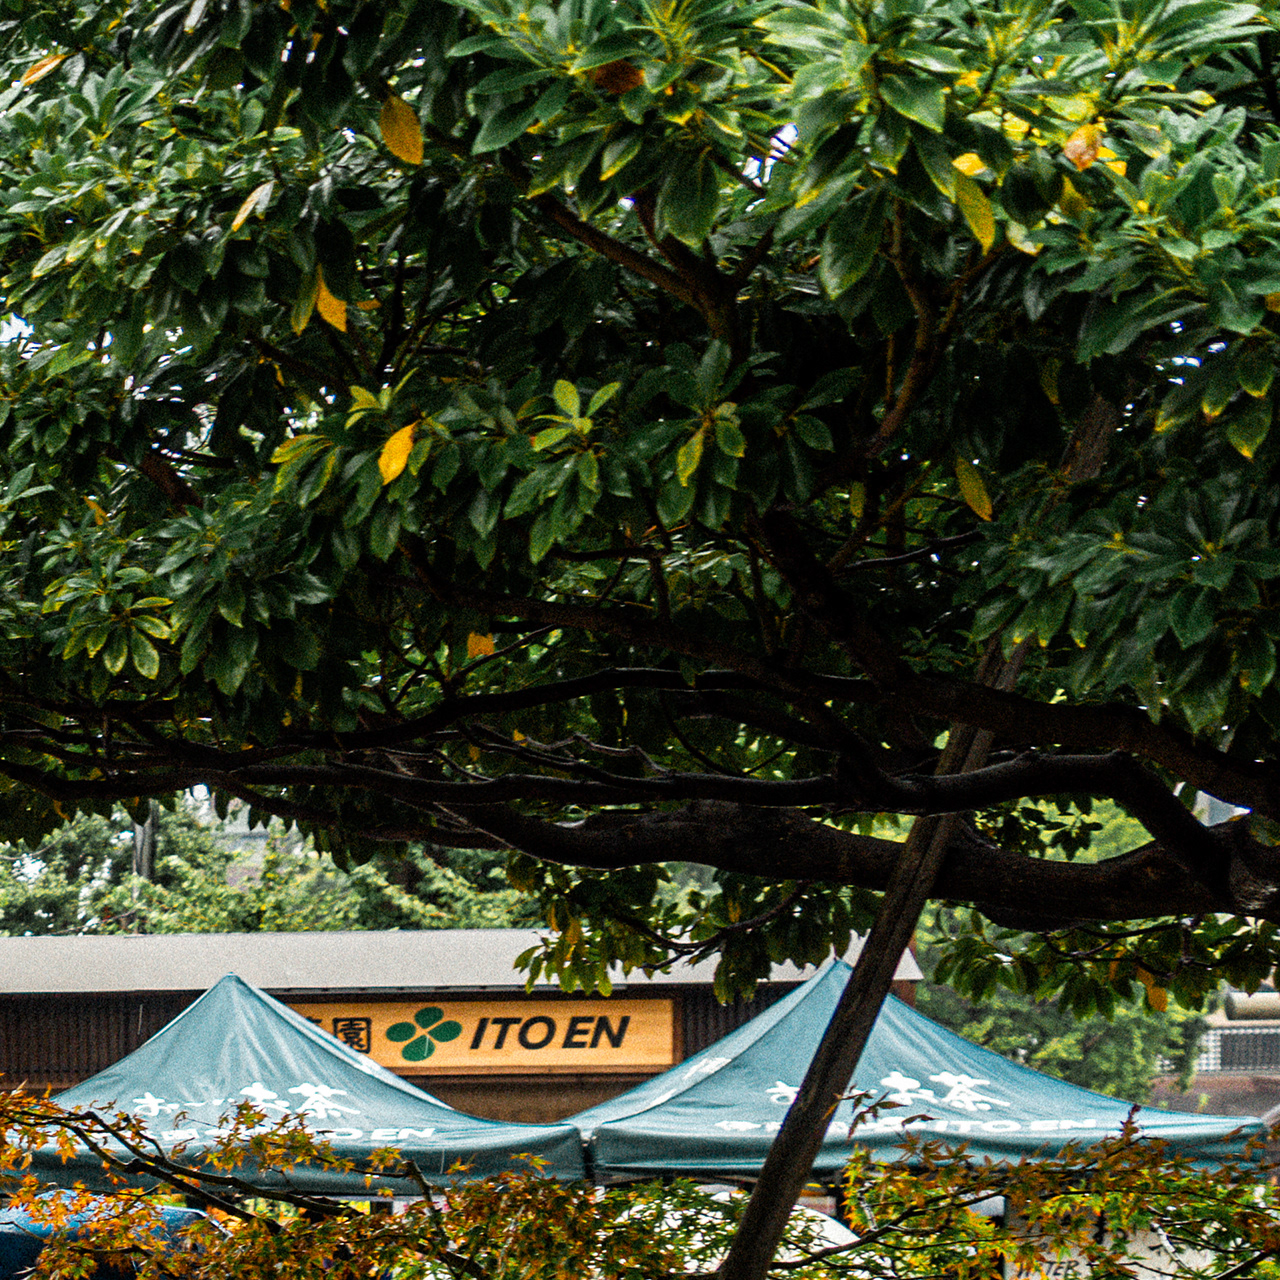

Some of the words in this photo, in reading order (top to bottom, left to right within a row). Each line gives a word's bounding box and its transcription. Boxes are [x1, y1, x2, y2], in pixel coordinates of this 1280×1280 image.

[470, 1016, 556, 1050] ITO
[562, 1015, 631, 1049] EN
[934, 1120, 1022, 1132] ITO
[1029, 1119, 1097, 1131] EN
[370, 1127, 436, 1141] EN
